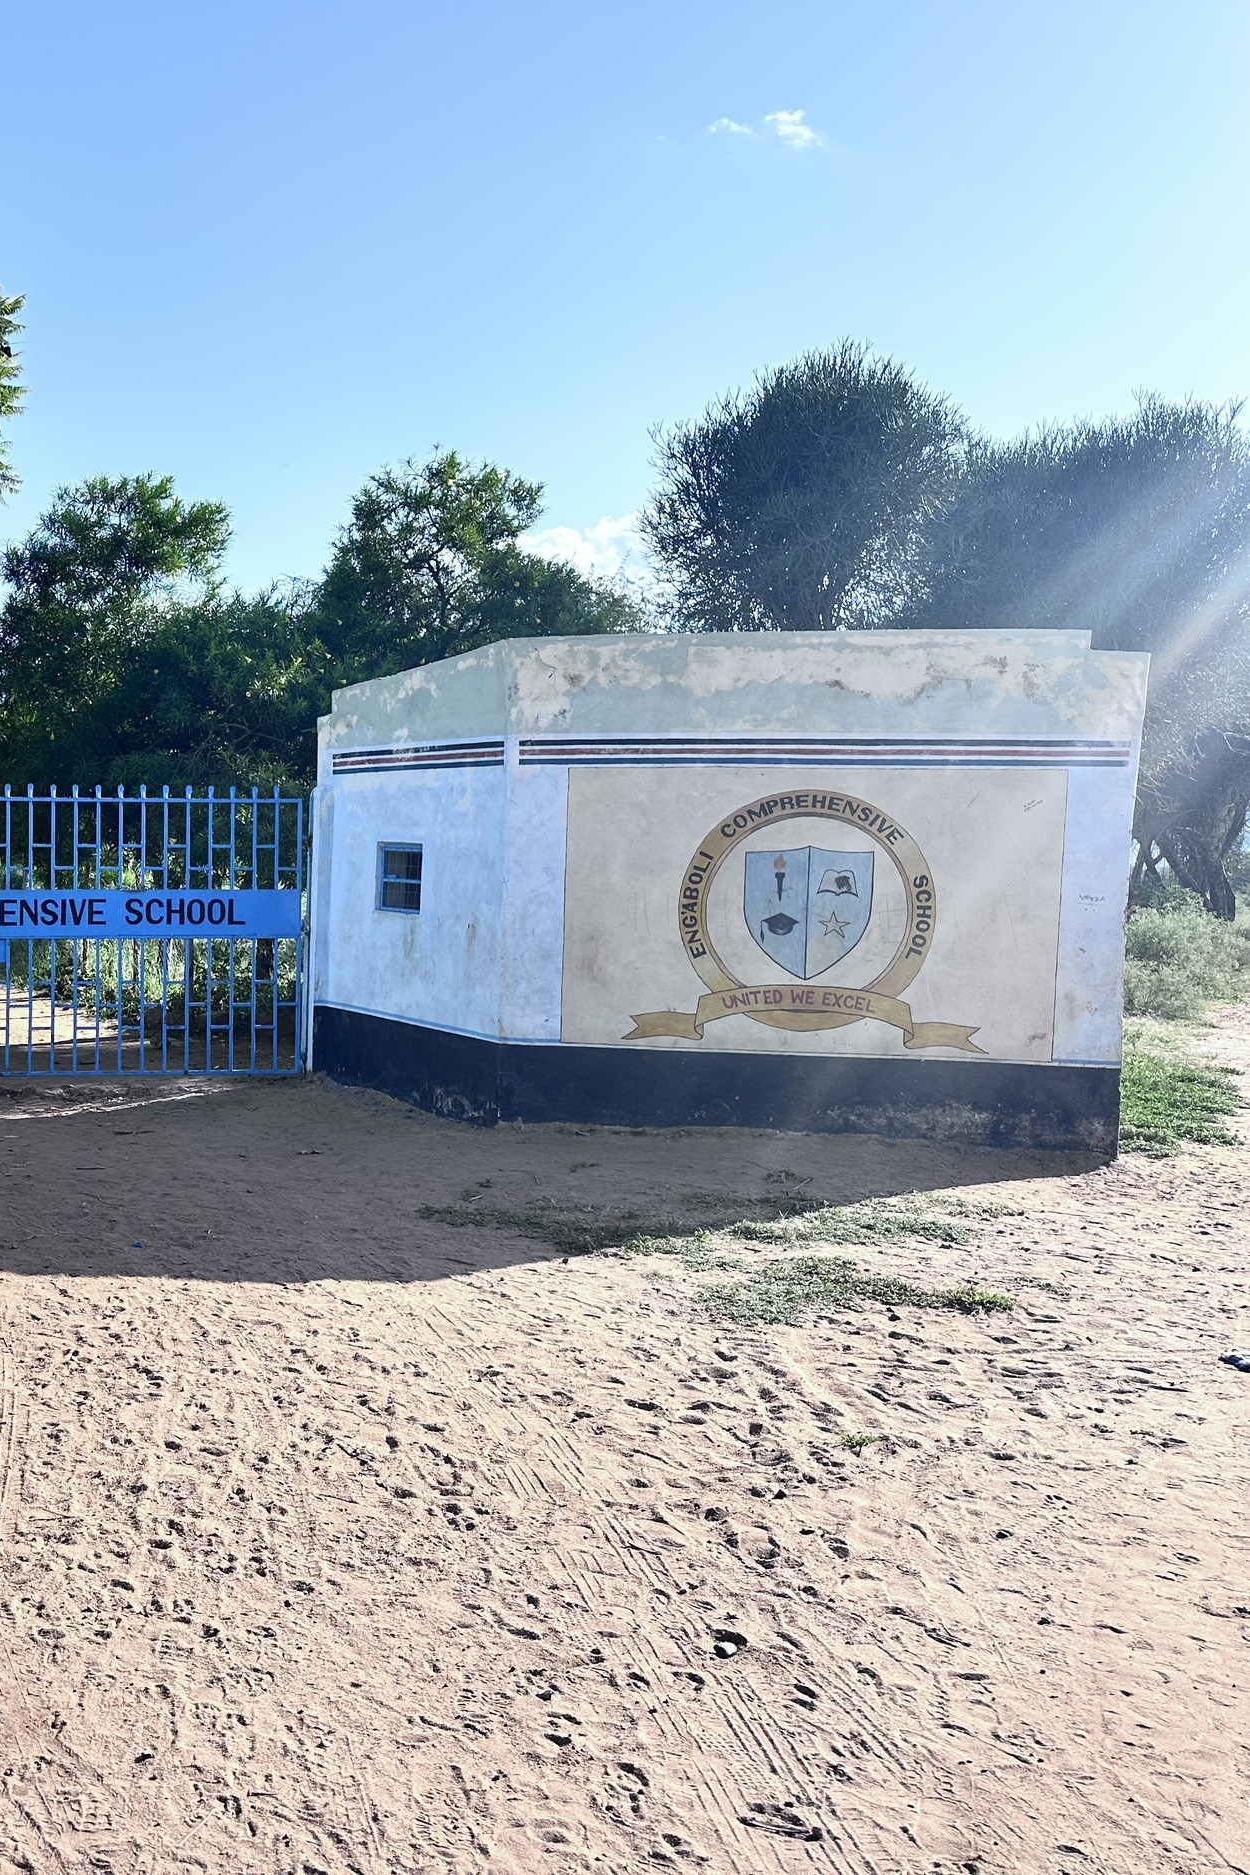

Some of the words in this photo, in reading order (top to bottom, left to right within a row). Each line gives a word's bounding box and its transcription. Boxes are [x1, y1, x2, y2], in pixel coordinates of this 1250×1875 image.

[680, 850, 715, 960] ENG'ABOLI
[720, 794, 905, 846] COMPREHENSIVE
[905, 874, 932, 960] SCHOOL
[124, 898, 246, 926] SCHOOL
[721, 989, 784, 1009] UNITED
[790, 989, 816, 1005] WE
[821, 991, 876, 1014] EXCEL
